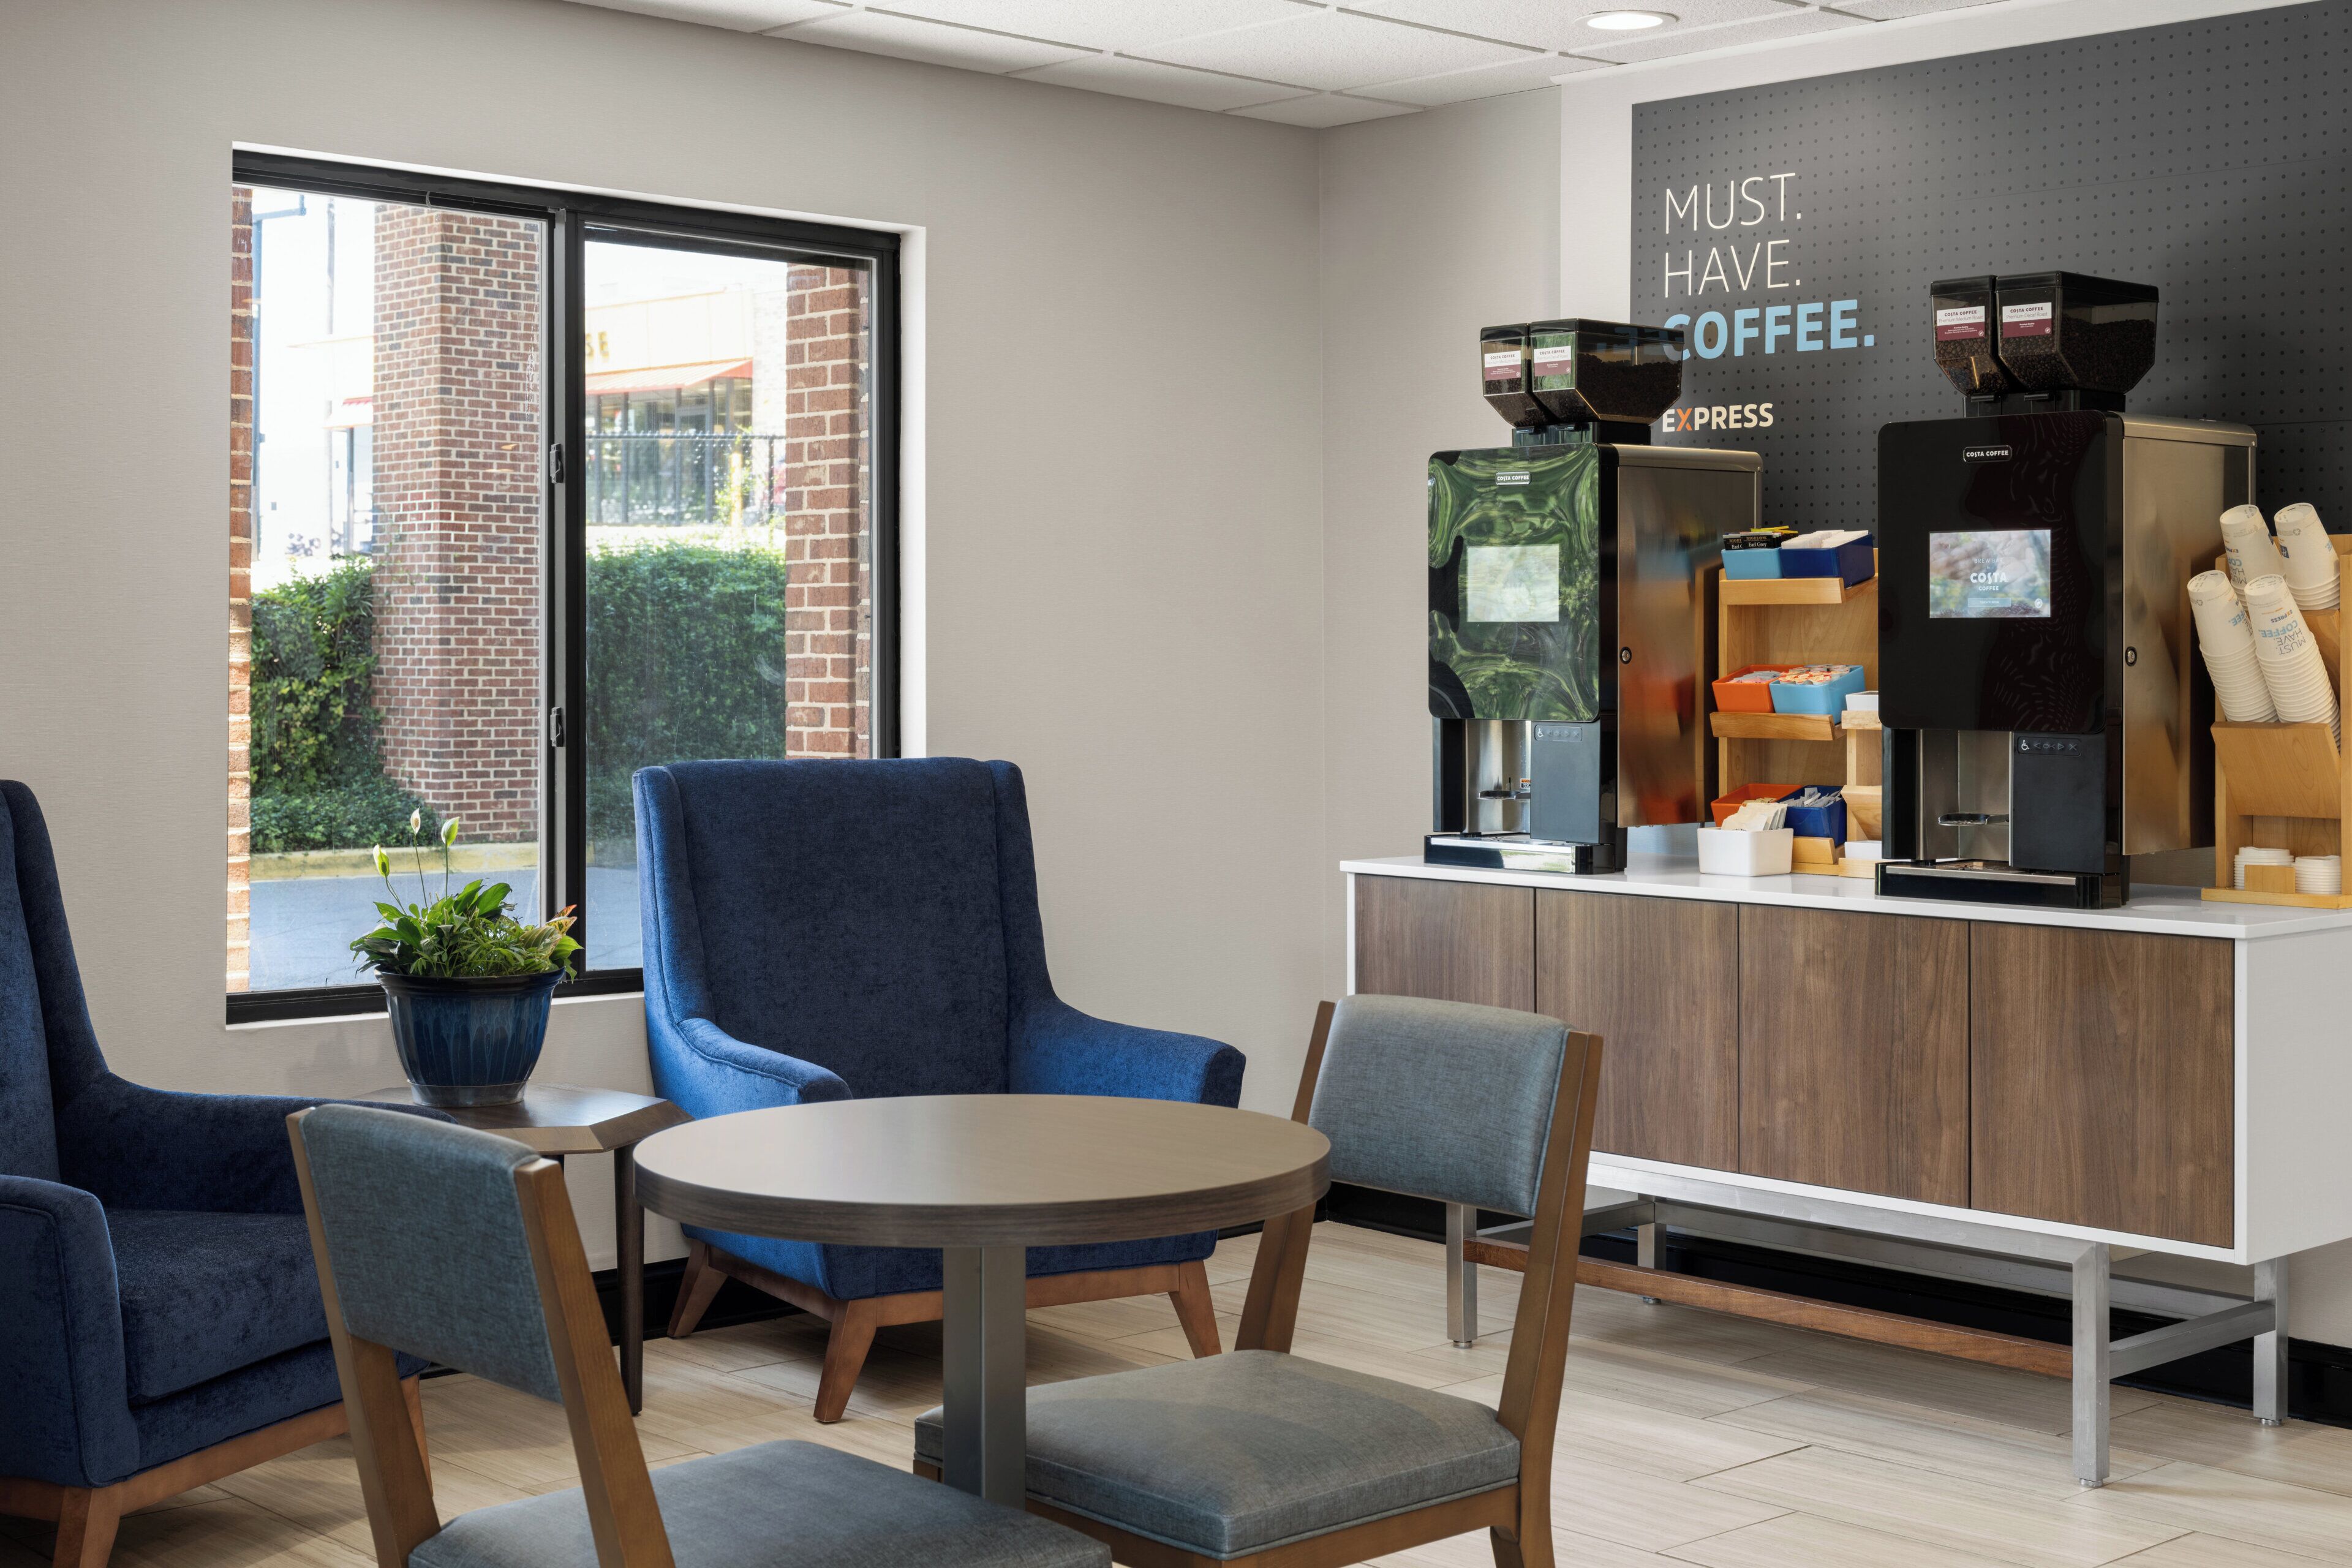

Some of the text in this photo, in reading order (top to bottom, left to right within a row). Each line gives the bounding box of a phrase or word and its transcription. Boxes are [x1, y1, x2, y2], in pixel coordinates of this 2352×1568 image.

[1665, 172, 1801, 235] MUST.
[1665, 239, 1801, 298] HAVE.
[1662, 299, 1874, 361] COFFEE.
[1662, 403, 1774, 432] EXPRESS
[1970, 572, 2008, 584] COSTA
[2271, 609, 2293, 623] EXPRESS
[2258, 620, 2298, 638] COFFEE.
[2273, 628, 2303, 646] HAVE.
[2275, 638, 2307, 655] MUST.
